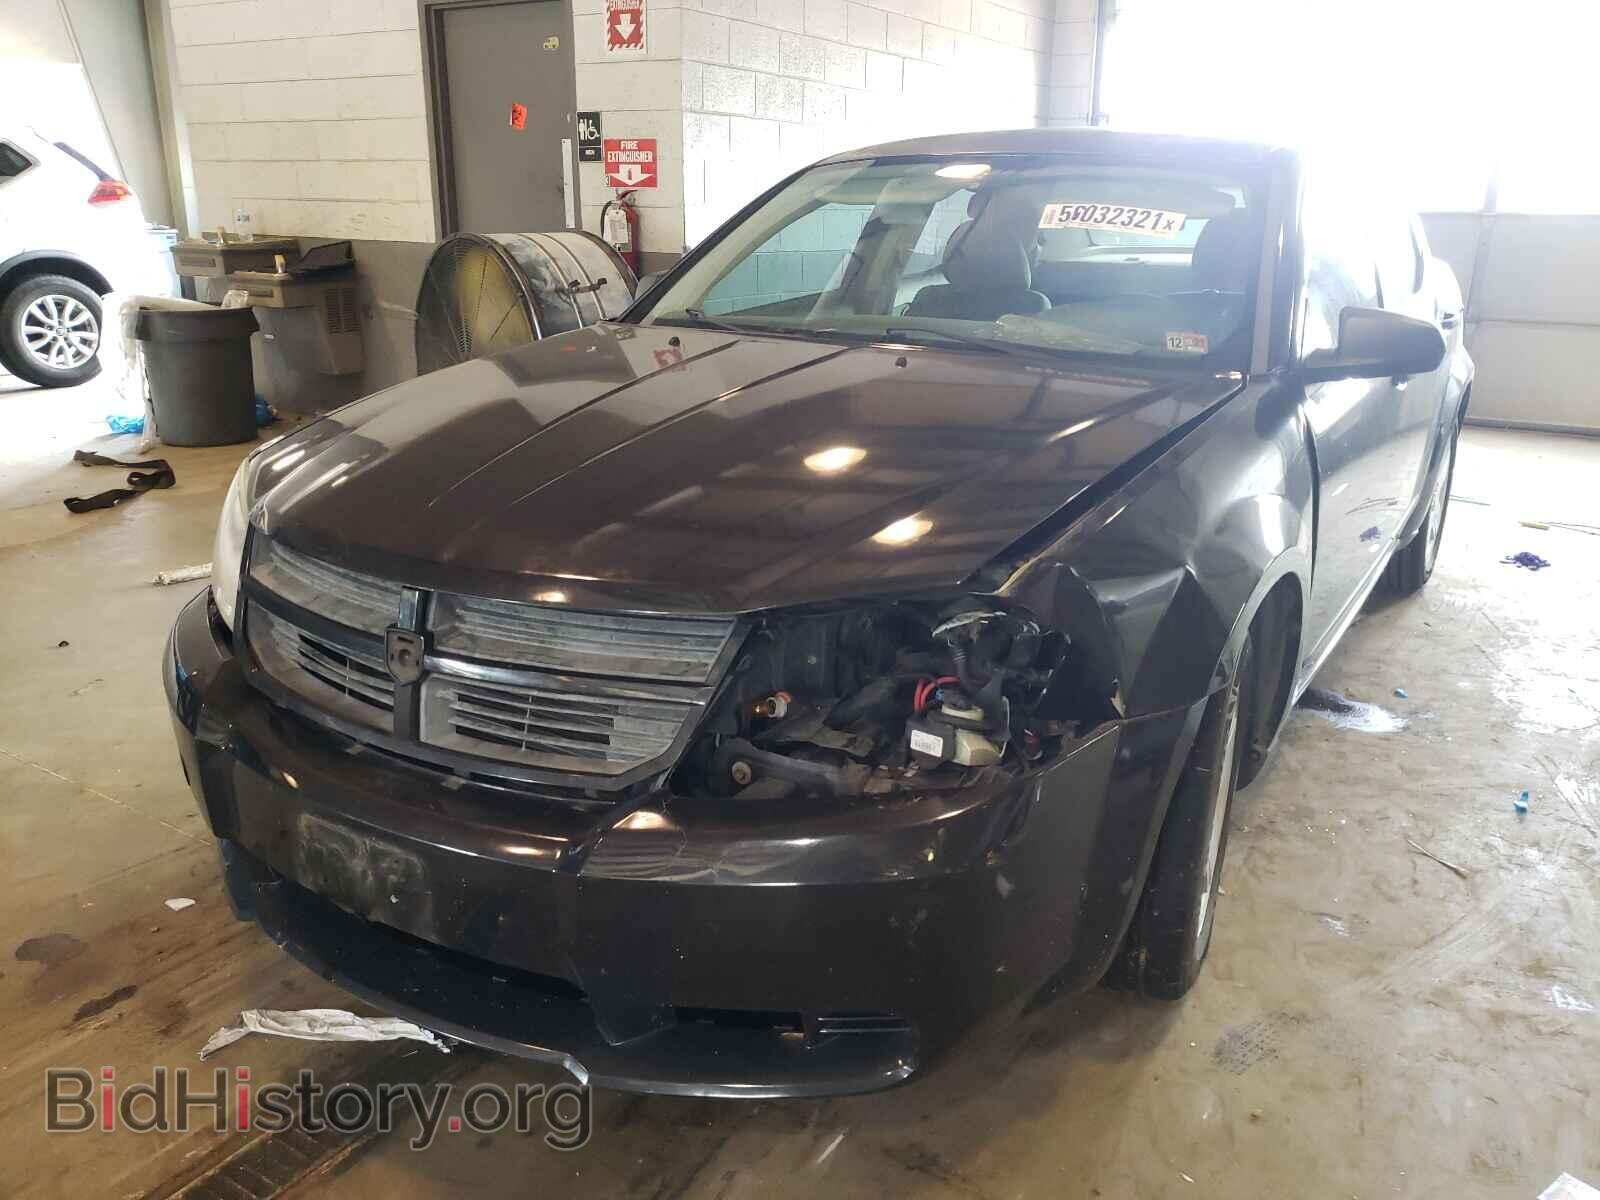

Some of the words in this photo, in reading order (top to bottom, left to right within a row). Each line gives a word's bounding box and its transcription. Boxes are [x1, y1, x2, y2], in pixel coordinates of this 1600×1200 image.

[620, 140, 639, 150] FIRE
[607, 151, 653, 163] EXTINGUISHER
[1168, 336, 1183, 348] 12
